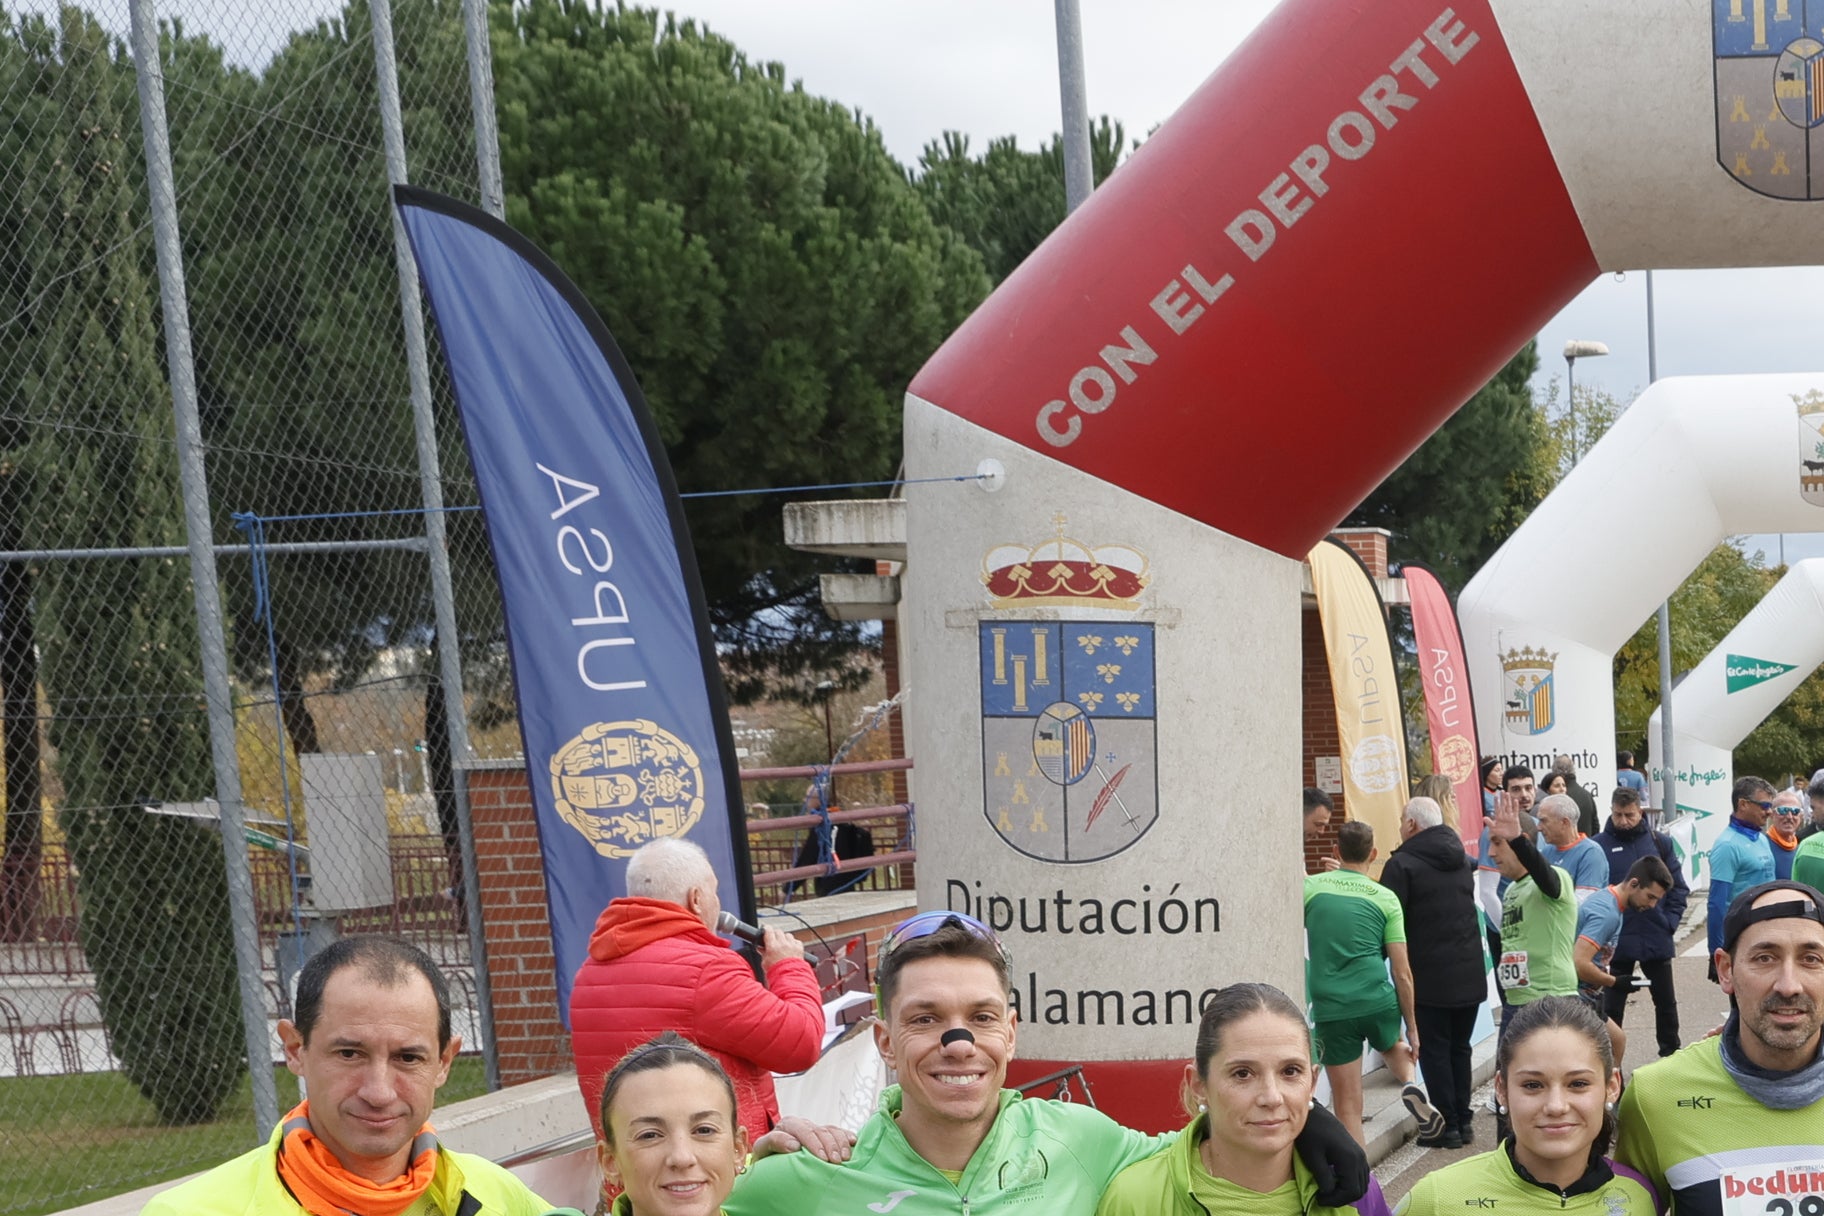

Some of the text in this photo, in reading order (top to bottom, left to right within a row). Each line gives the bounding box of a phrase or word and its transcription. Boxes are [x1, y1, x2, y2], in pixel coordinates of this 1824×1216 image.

[1036, 7, 1480, 448] CON EL DEPORTE
[946, 879, 1220, 935] Diputación
